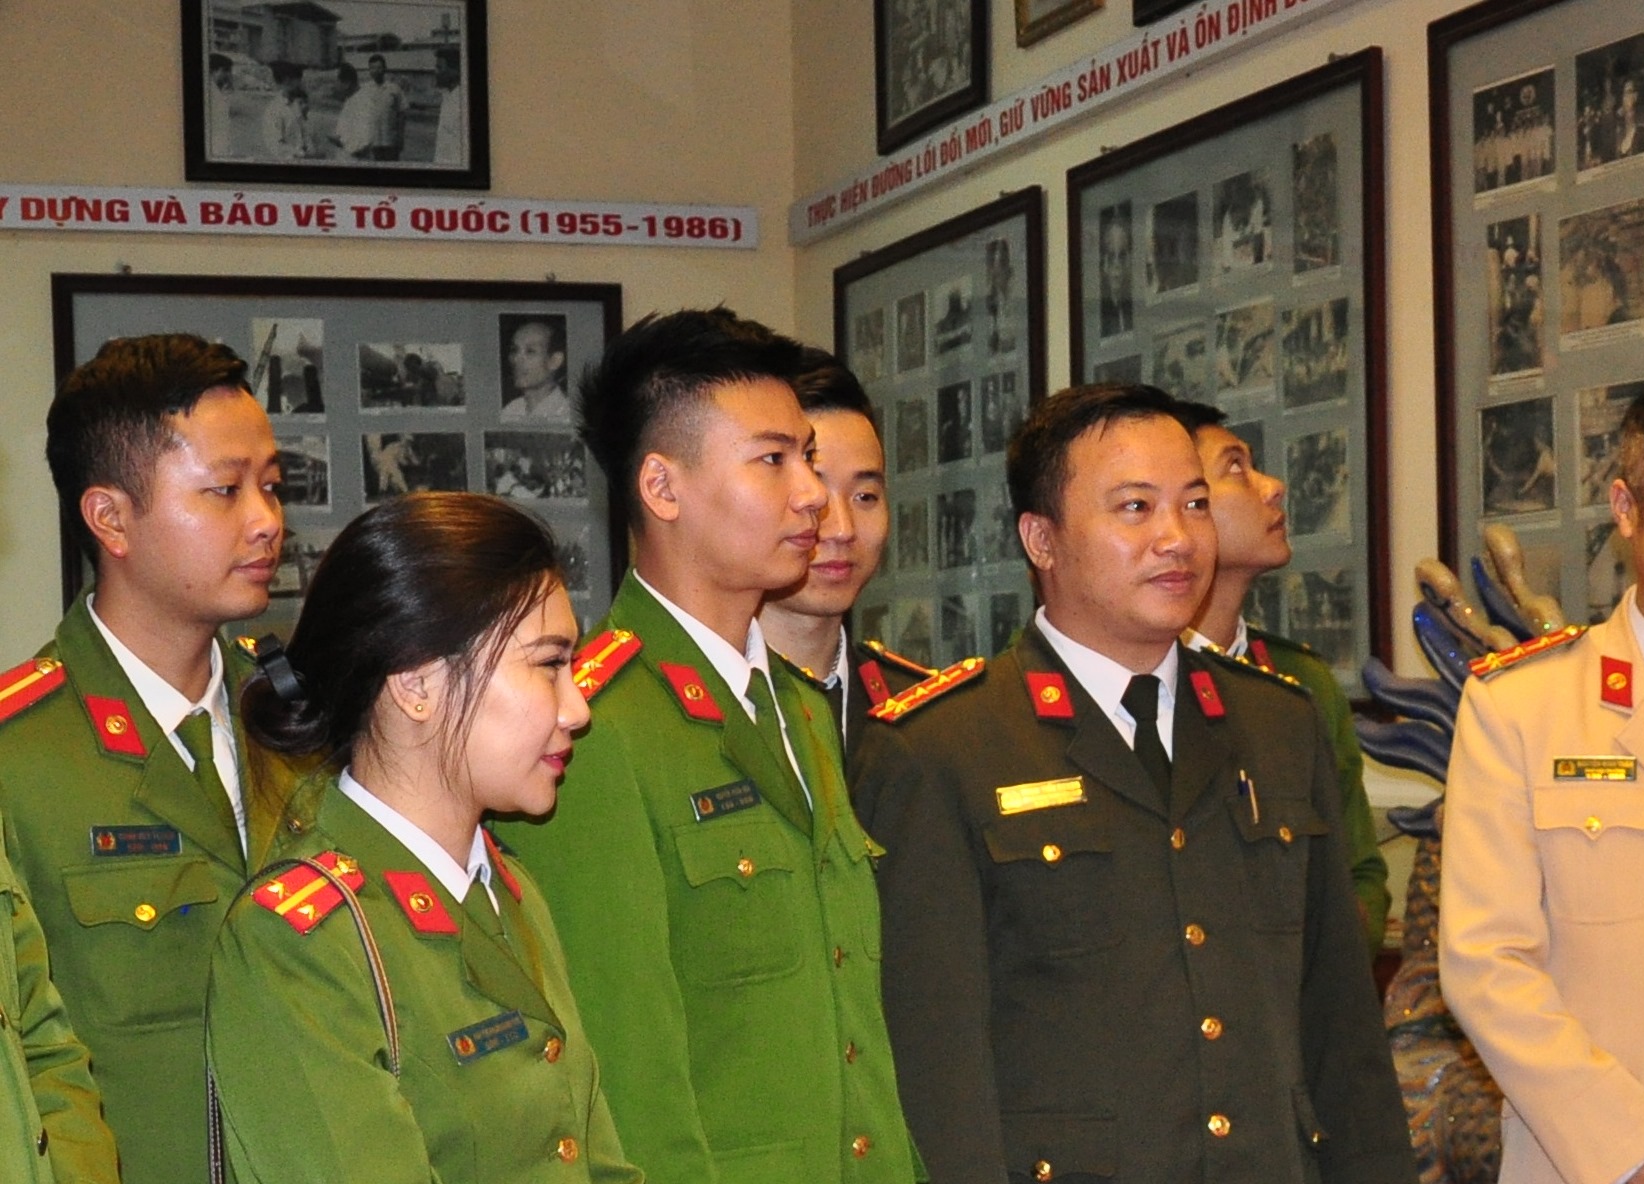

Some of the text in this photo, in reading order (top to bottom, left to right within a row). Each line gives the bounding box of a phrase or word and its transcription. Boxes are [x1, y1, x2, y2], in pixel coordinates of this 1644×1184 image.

[1077, 58, 1111, 102] SẢN
[1117, 32, 1161, 83] XUẤT
[1166, 20, 1190, 63] VÀ
[20, 195, 130, 228] DỰNG
[140, 194, 187, 225] VÀ
[200, 192, 278, 227] BẢO
[292, 199, 337, 232] VỆ
[350, 194, 398, 230] TỔ
[410, 201, 510, 235] QUỐC
[520, 209, 743, 242] (1955-1986)
